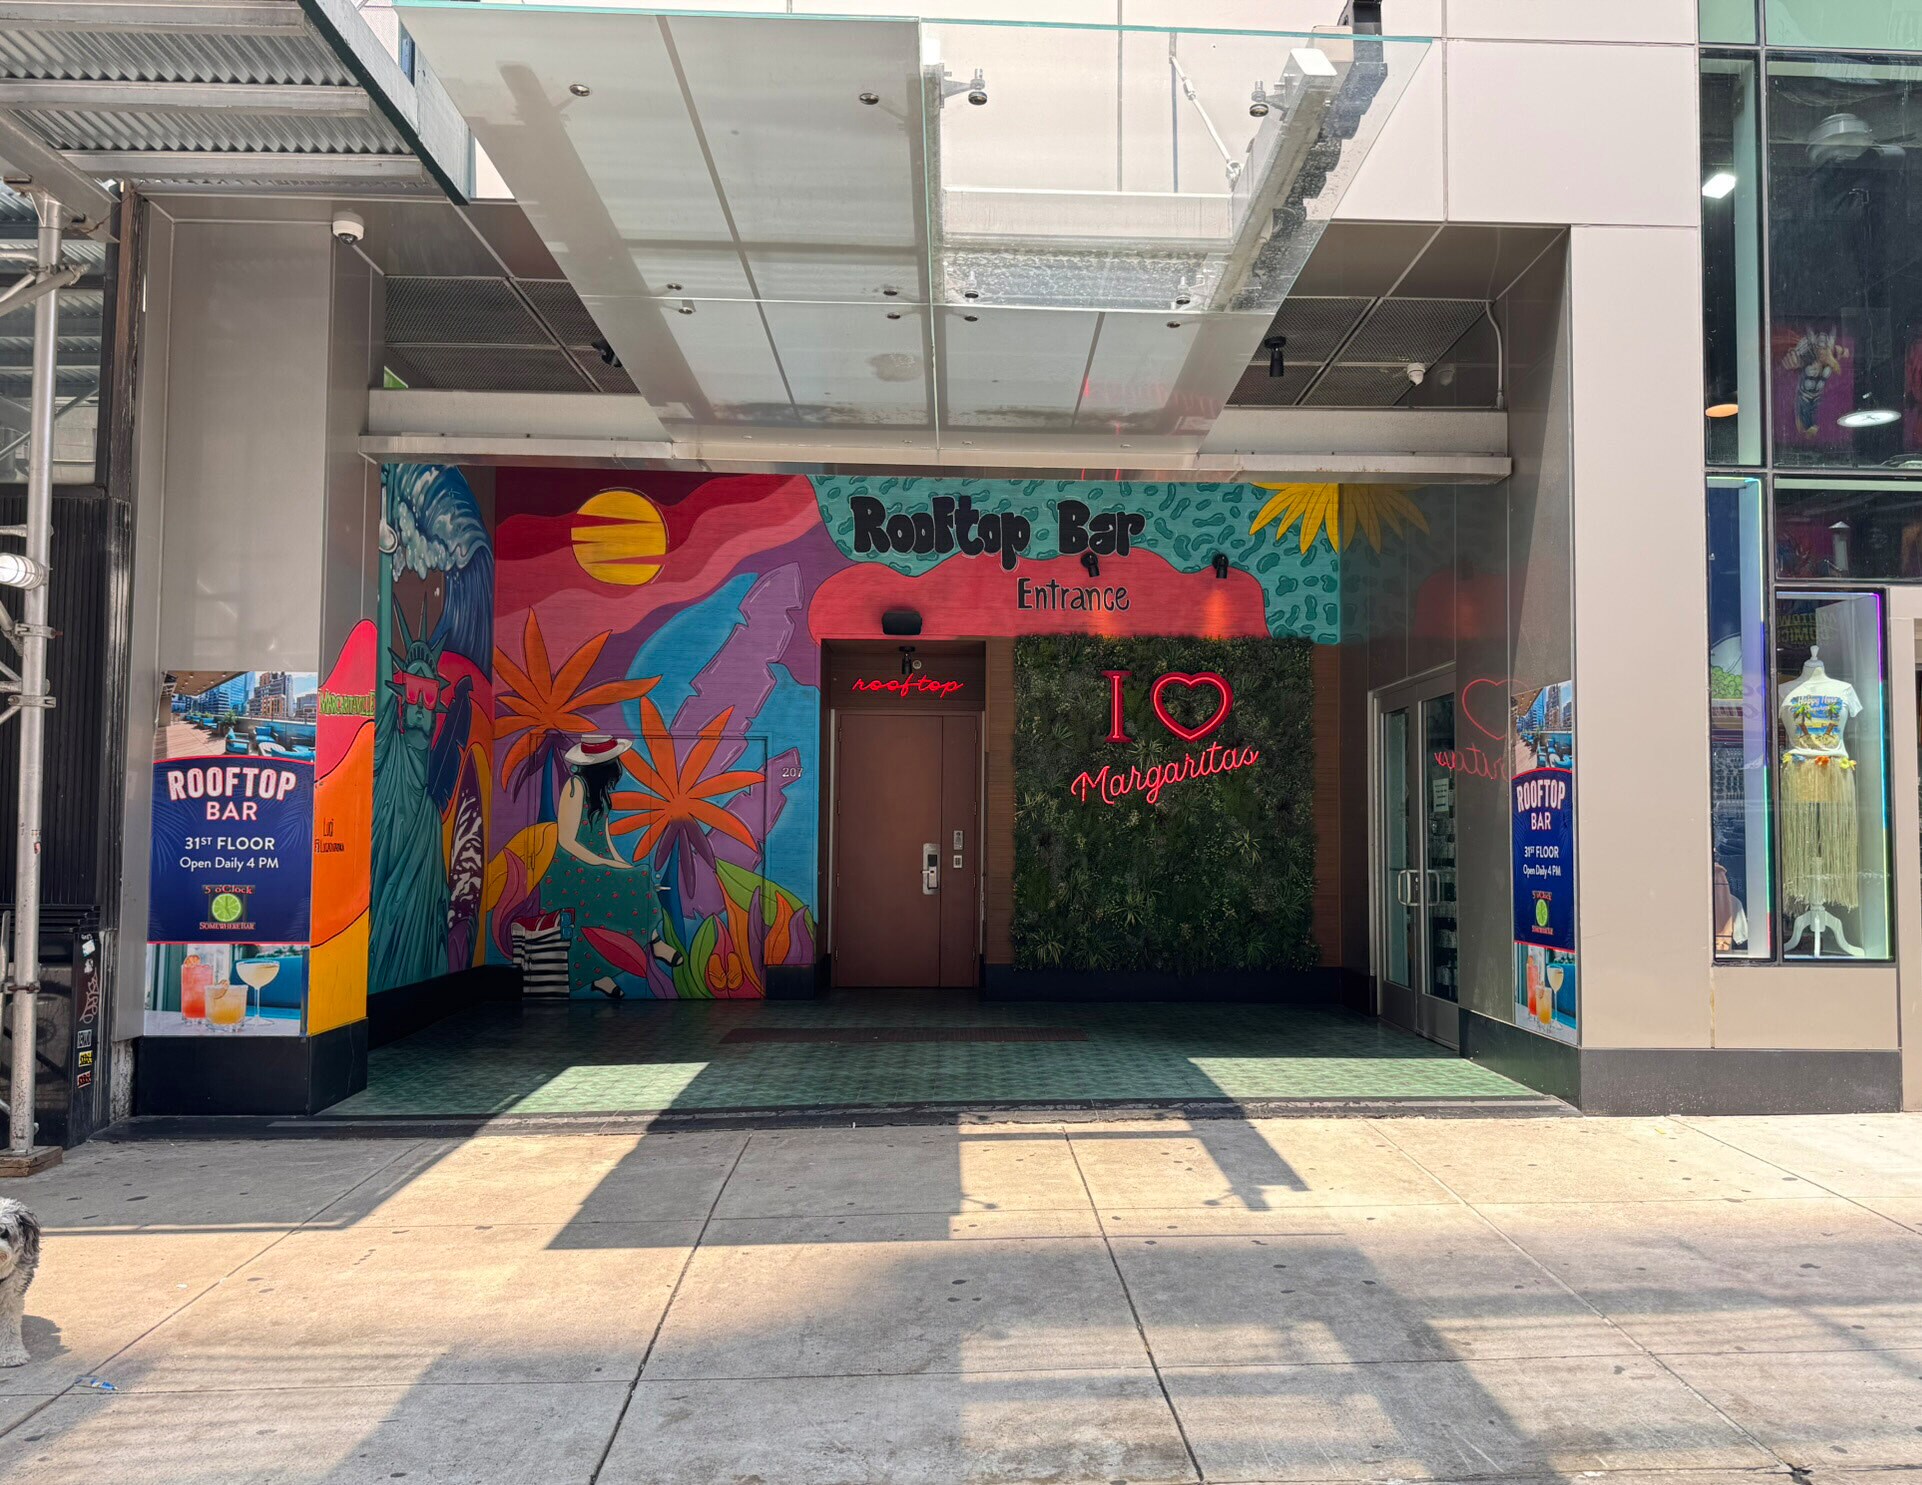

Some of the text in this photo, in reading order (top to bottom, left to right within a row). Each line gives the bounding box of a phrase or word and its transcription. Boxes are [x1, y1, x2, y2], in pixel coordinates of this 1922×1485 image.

[1057, 498, 1147, 557] Bar
[1017, 577, 1131, 612] Entrance
[852, 673, 964, 698] rooftop
[1101, 670, 1133, 743] I
[781, 767, 803, 778] 207
[1071, 742, 1260, 805] Margaritas
[167, 766, 298, 801] ROOFTOP
[1516, 779, 1566, 813] ROOFTOP
[206, 801, 258, 821] BAR
[1530, 812, 1552, 830] BAR
[184, 837, 275, 850] 31ST FLOOR
[1536, 845, 1559, 858] FLOOR
[179, 856, 279, 872] Open Daily 4 PM
[1523, 864, 1535, 878] Open
[1536, 864, 1547, 880] Daily
[1552, 864, 1562, 876] PM
[204, 886, 212, 894] 5
